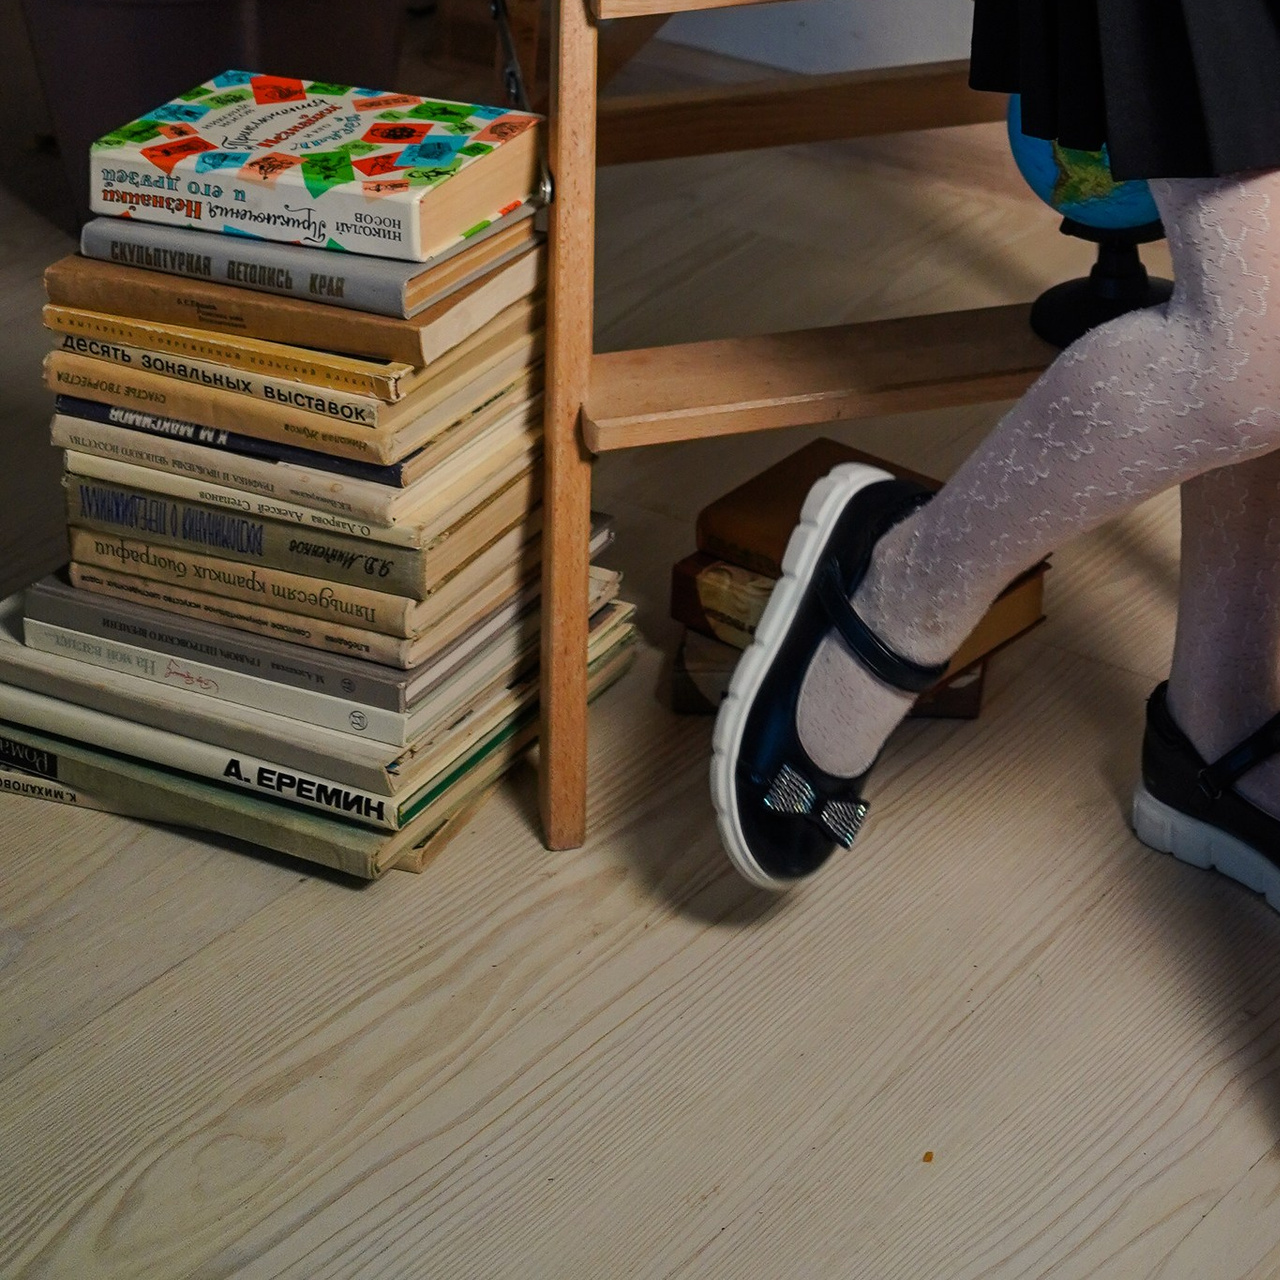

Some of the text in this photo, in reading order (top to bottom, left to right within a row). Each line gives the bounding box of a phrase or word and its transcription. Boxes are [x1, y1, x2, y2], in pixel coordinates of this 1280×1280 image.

[99, 166, 247, 201] и его друзей
[100, 188, 328, 242] Приключения Незнайки
[354, 213, 401, 228] НОСОВ
[335, 222, 402, 241] НИКОЛАЙ
[108, 240, 345, 298] СКУЛЬПТУРНАЯ ЛЕТОПИСЬ КРАЯ
[147, 334, 240, 359] СОВРЕМЕННЫЙ
[249, 356, 315, 376] ПОЛЬСКИЙ
[139, 354, 253, 393] зональных
[263, 385, 367, 422] выставок
[56, 370, 367, 450] Николай Жуков СЧАСТЬЕ ТВОРЧЕСТВА
[67, 433, 119, 453] ИСКУССТВА
[230, 473, 275, 493] ГРАФИКА
[197, 490, 250, 510] Степанов
[256, 503, 304, 521] Алексей
[80, 573, 104, 586] годов
[189, 557, 268, 595] кратких
[268, 576, 379, 623] Пятьдесят
[101, 618, 148, 638] ВРЕМЕНИ
[148, 630, 218, 655] ПЕТРОВСКОГО
[105, 647, 134, 668] мой
[135, 656, 157, 675] На
[223, 757, 387, 820] А. ЕРЕМИН
